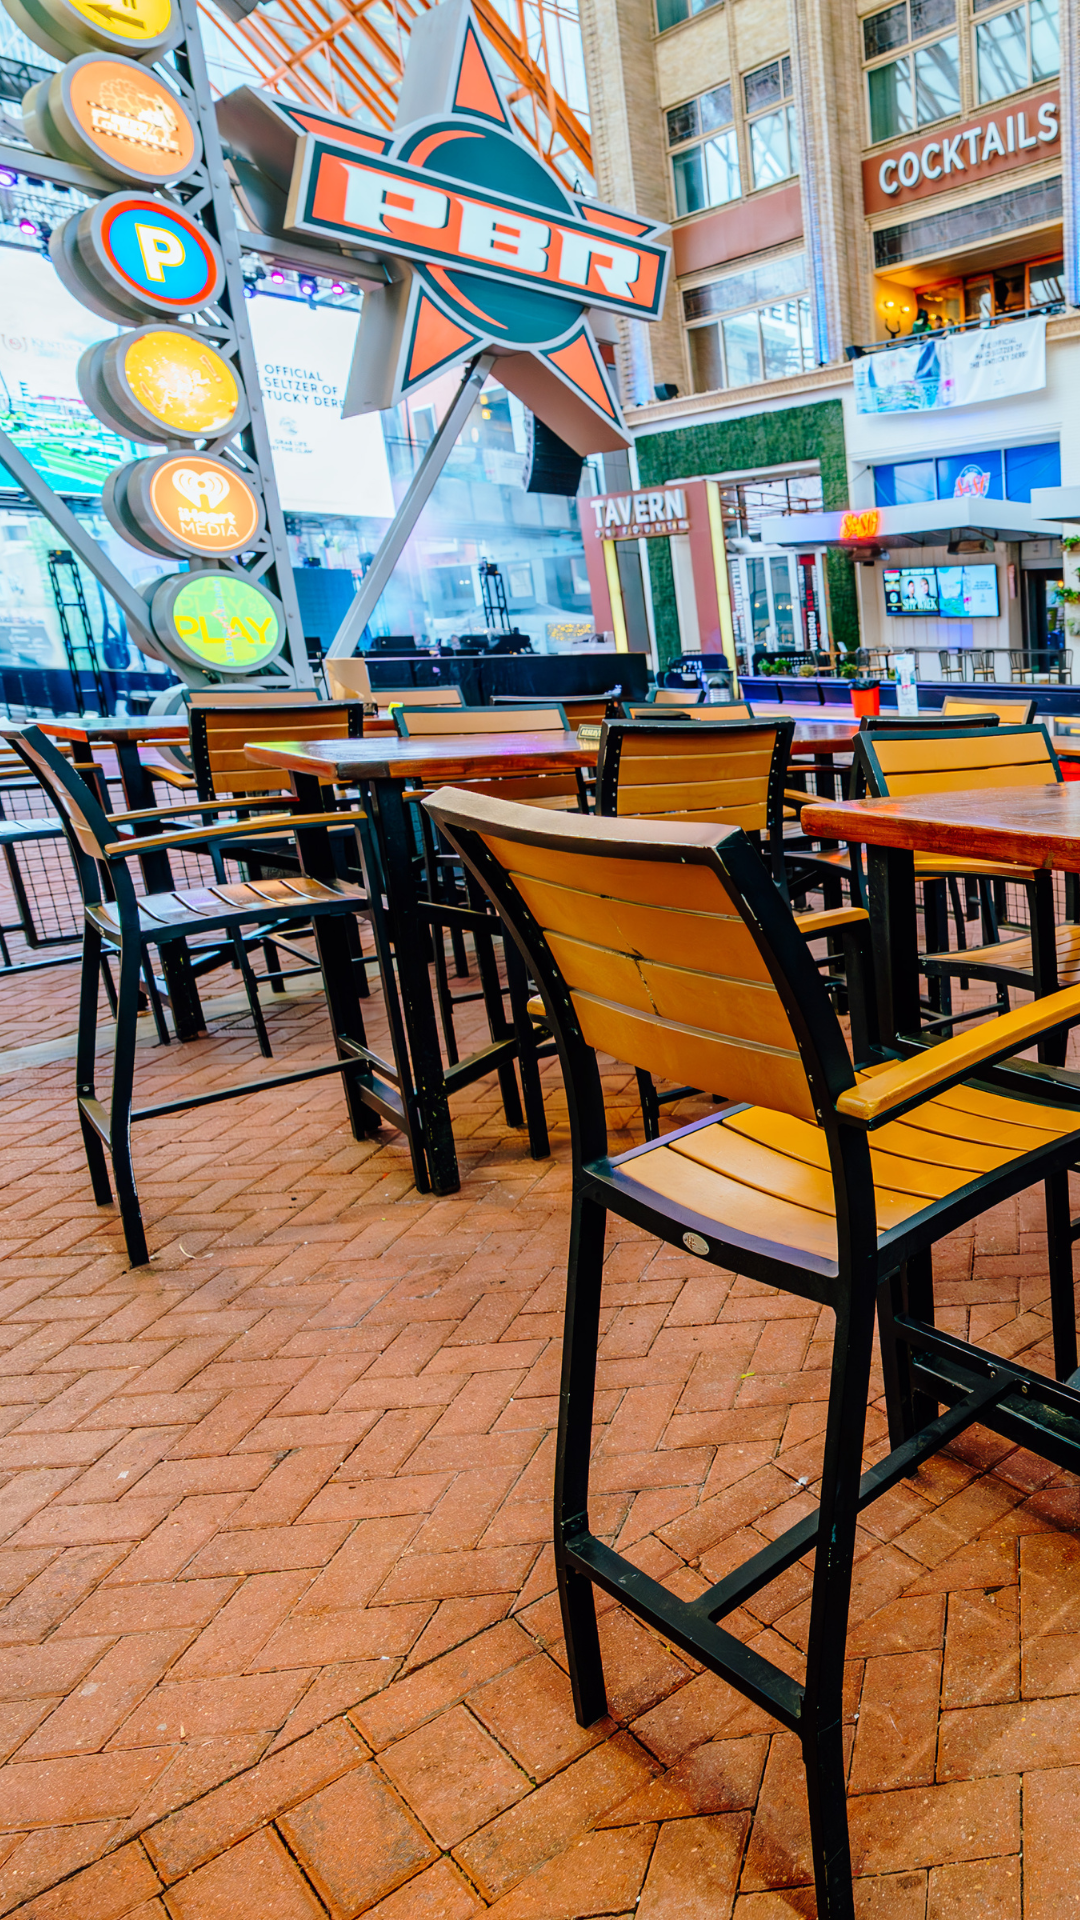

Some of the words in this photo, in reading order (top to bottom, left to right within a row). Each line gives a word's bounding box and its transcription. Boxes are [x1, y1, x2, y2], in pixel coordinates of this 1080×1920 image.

[878, 102, 1060, 195] COCKTAILS
[338, 161, 640, 299] PBR
[134, 222, 186, 282] P
[264, 364, 323, 382] OFFICIAL
[263, 389, 310, 405] TUCKY
[264, 376, 318, 393] SELTZER
[322, 384, 338, 395] OF
[178, 506, 237, 526] iHeart
[590, 488, 686, 529] TAVERN
[180, 521, 240, 538] MEDIA
[173, 615, 273, 644] PLAY
